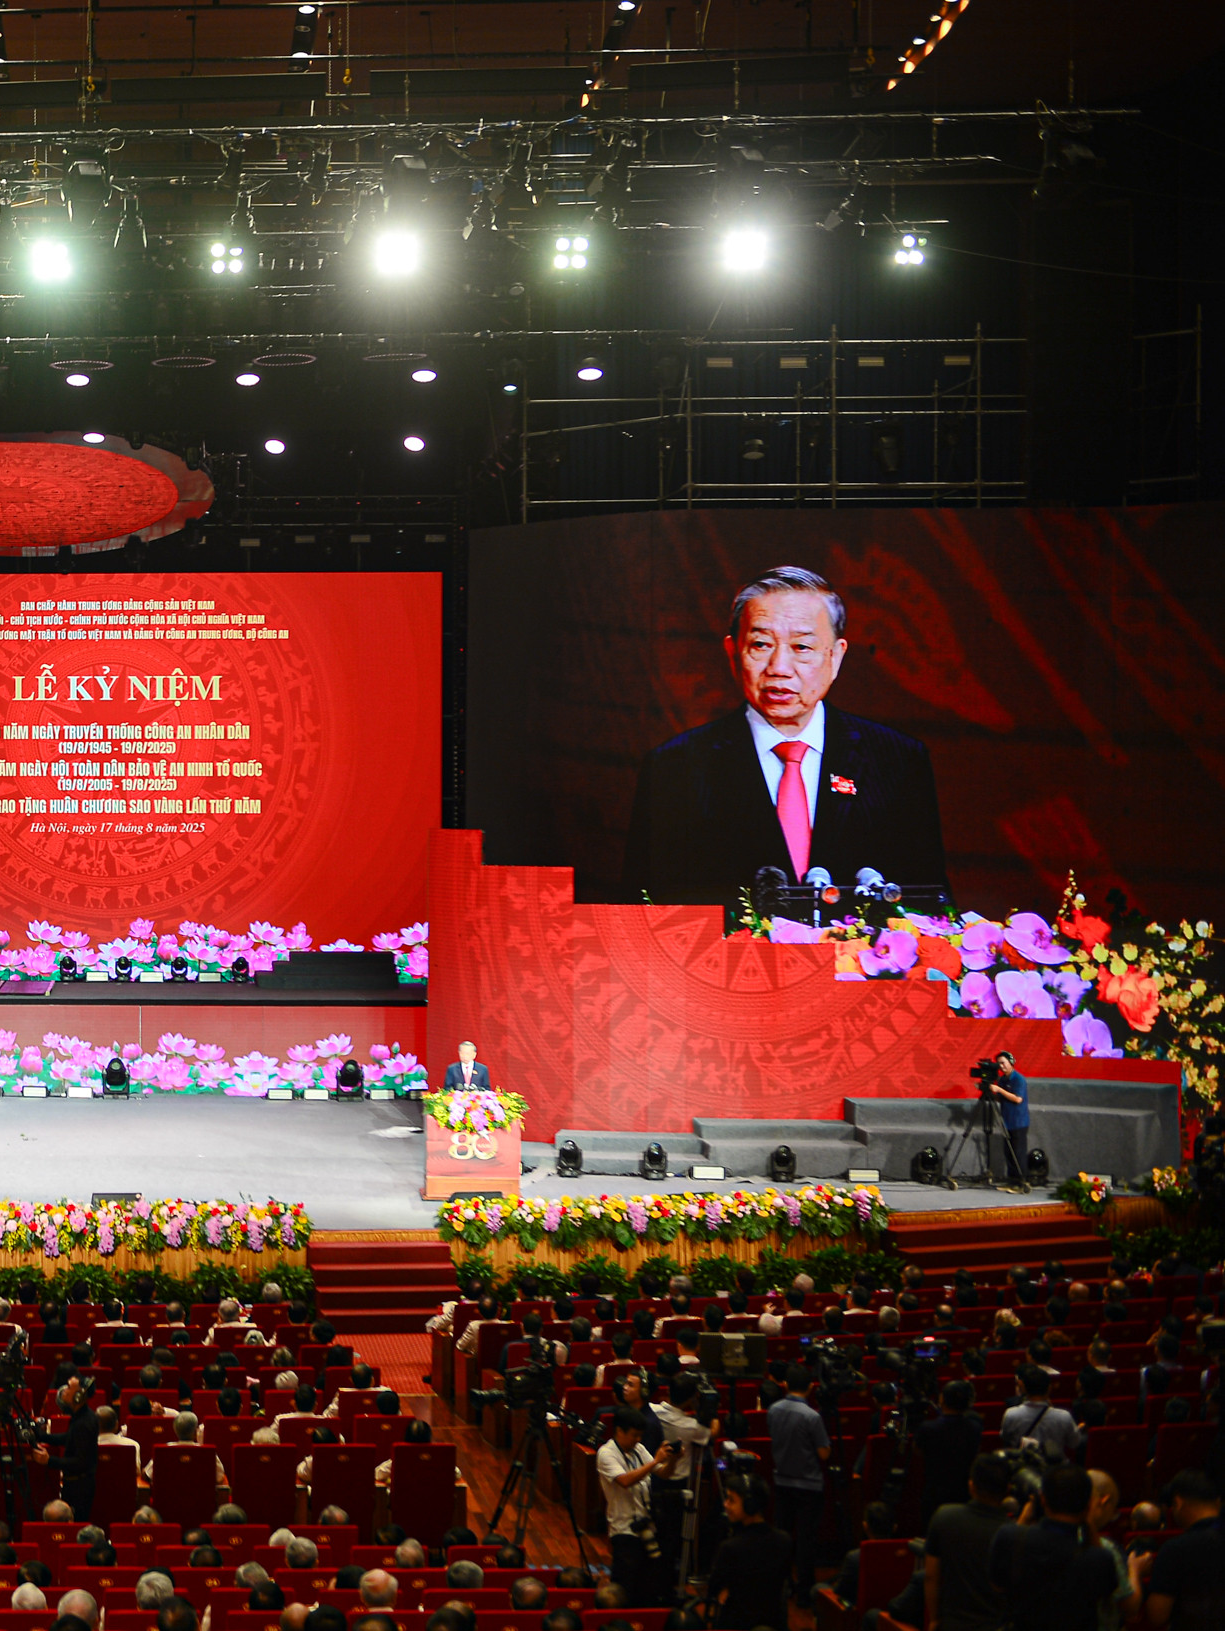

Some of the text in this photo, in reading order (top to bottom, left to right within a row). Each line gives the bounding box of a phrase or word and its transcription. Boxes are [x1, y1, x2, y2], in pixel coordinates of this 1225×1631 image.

[20, 598, 215, 612] BAN CHẤP HÀNH TRUNG ƯƠNG ĐẢNG CỘNG SẢN VIỆT NAM
[10, 613, 24, 625] CHỦ
[26, 616, 42, 627] TỊCH
[43, 614, 64, 625] NƯỚC
[70, 614, 92, 625] CHÍNH
[92, 613, 107, 624] PHỦ
[108, 614, 129, 624] NƯỚC
[130, 614, 149, 626] CỘNG
[150, 614, 165, 624] HÒA
[166, 614, 176, 624] XÃ
[178, 614, 190, 626] HỘI
[192, 612, 206, 624] CHỦ
[208, 613, 230, 624] NGHĨA
[230, 613, 246, 626] VIỆT
[248, 615, 265, 624] NAM
[20, 629, 36, 642] MẶT
[38, 629, 56, 642] TRẬN
[68, 628, 87, 641] QUỐC
[88, 628, 103, 642] VIỆT
[104, 630, 122, 640] NAM
[123, 628, 133, 640] VÀ
[134, 628, 154, 640] ĐẢNG
[155, 628, 165, 640] ỦY
[166, 628, 186, 640] CÔNG
[186, 630, 198, 640] AN
[198, 630, 222, 640] TRUNG
[222, 630, 245, 641] ƯƠNG,
[246, 628, 256, 642] BỘ
[258, 628, 277, 640] CÔNG
[278, 630, 290, 640] AN
[12, 664, 223, 707] LỄ KỶ NIỆM
[3, 722, 29, 739] NĂM
[32, 723, 60, 739] NGÀY
[63, 722, 103, 739] TRUYỀN
[106, 722, 142, 739] THỐNG
[144, 722, 174, 739] CÔNG
[177, 725, 191, 739] AN
[194, 722, 224, 739] NHÂN
[227, 722, 250, 739] DÂN
[58, 742, 112, 754] (19/8/1945
[121, 742, 176, 754] 19/8/2025)
[20, 760, 48, 777] NGÀY
[51, 760, 69, 780] HỘI
[72, 760, 100, 777] TOÀN
[103, 759, 126, 776] DÂN
[128, 758, 150, 777] BẢO
[153, 759, 167, 780] VỆ
[169, 762, 184, 777] AN
[187, 762, 213, 777] NINH
[233, 759, 263, 777] QUỐC
[57, 779, 113, 791] (19/8/2005
[122, 779, 177, 791] 19/8/2025)
[19, 796, 46, 816] TẶNG
[50, 796, 79, 814] HUÂN
[82, 798, 126, 814] CHƯƠNG
[129, 799, 151, 814] SAO
[154, 797, 183, 814] VÀNG
[210, 797, 232, 814] THỨ
[234, 797, 261, 814] NĂM
[30, 822, 205, 834] Hà Nội, ngày 17 tháng 8 năm 2025
